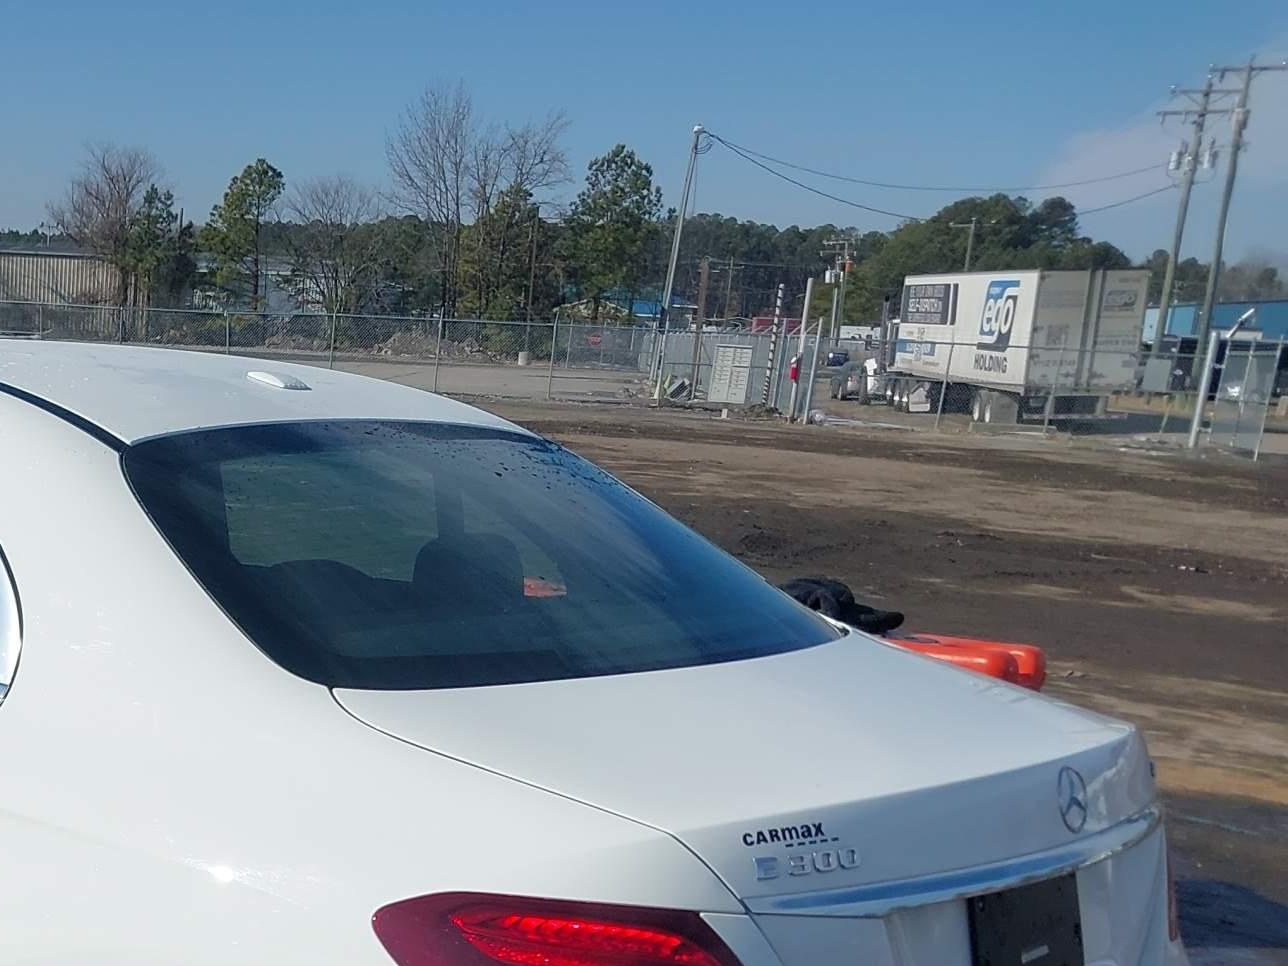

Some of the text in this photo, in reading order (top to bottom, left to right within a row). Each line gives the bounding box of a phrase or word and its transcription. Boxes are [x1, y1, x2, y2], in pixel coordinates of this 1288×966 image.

[973, 353, 1008, 374] HOLDING
[753, 849, 861, 880] E 300
